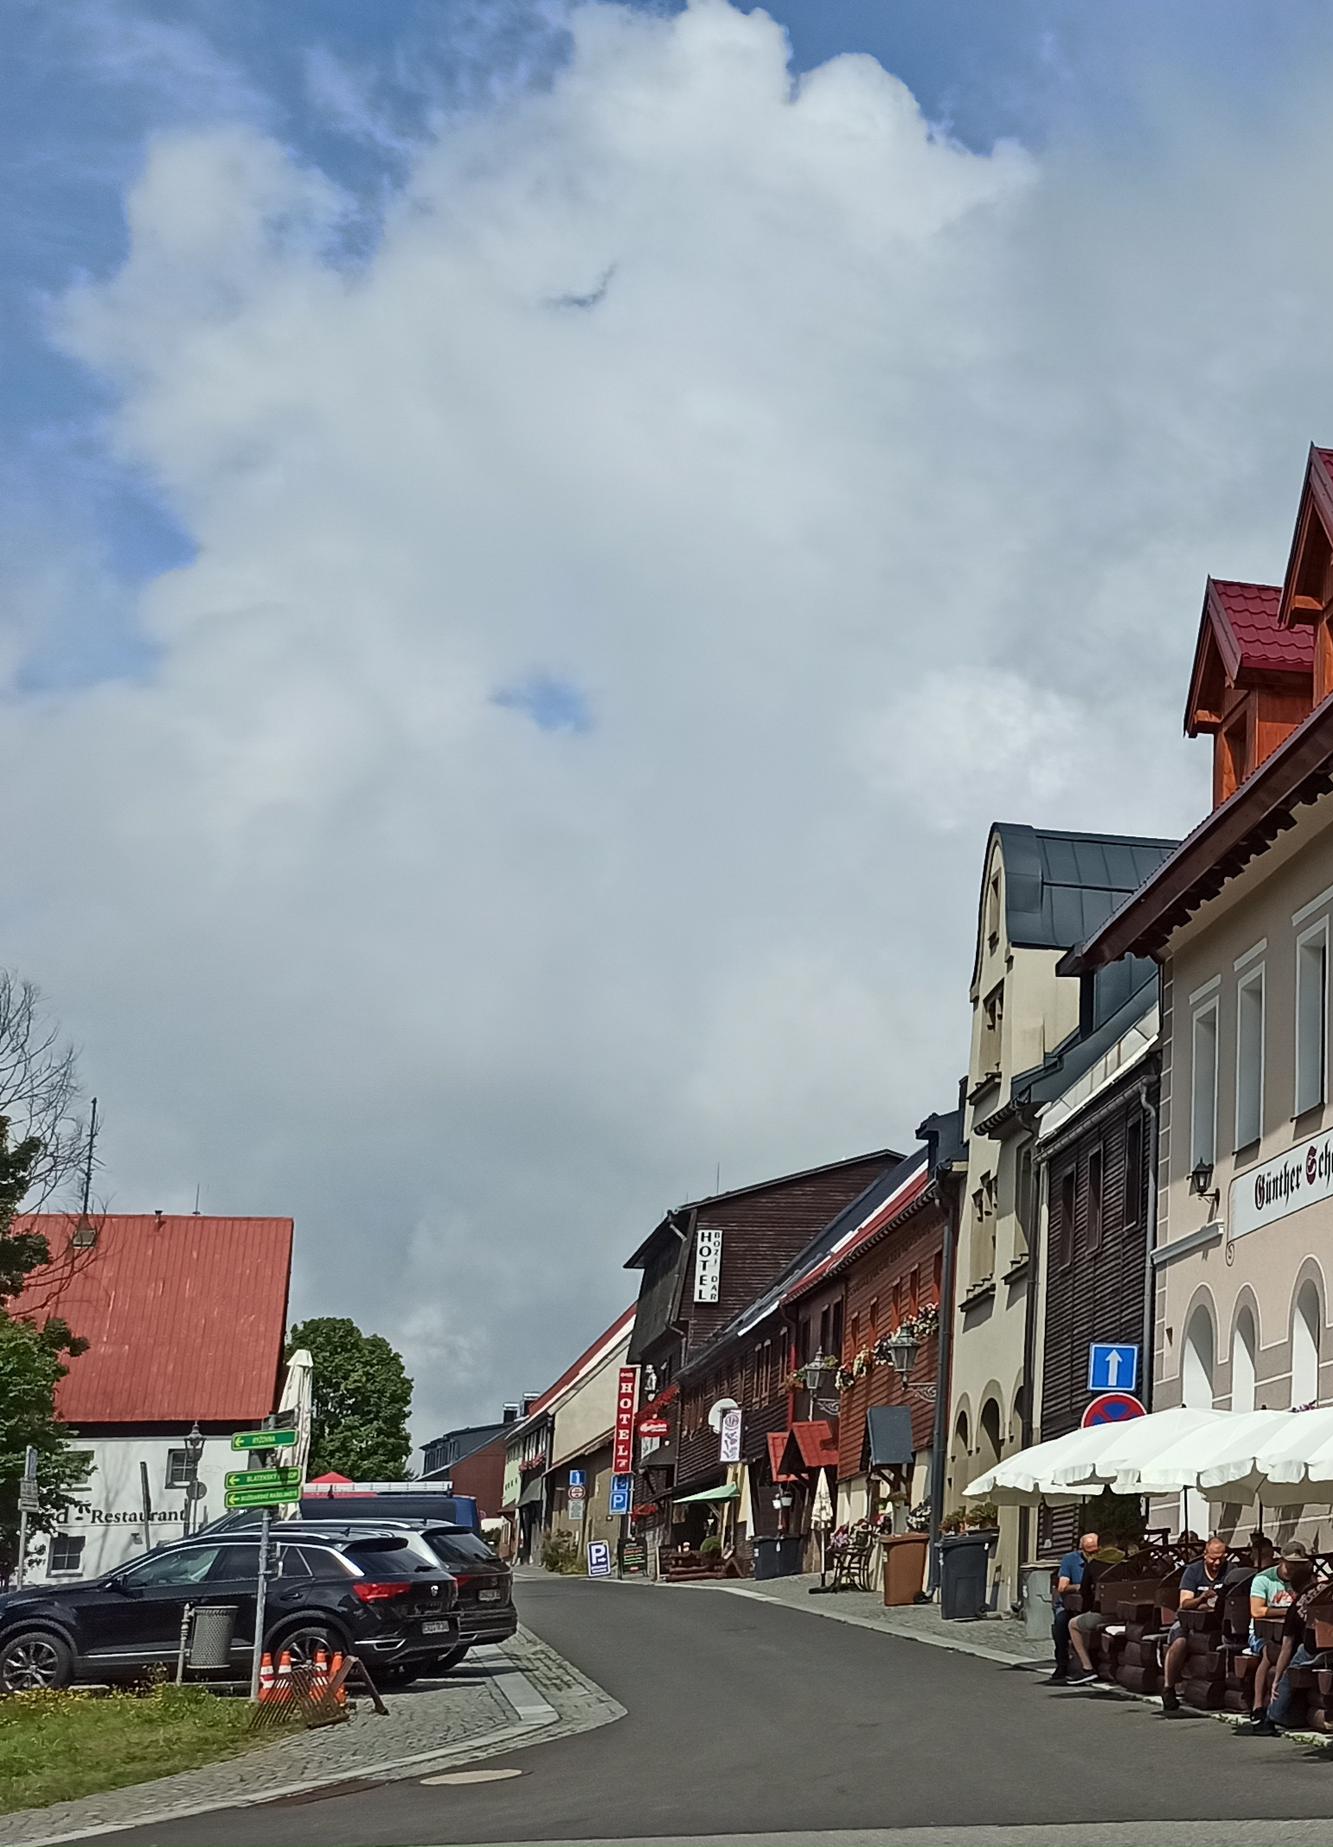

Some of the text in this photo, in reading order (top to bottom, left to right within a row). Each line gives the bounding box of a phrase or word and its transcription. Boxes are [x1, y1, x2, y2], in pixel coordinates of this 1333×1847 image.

[1254, 1159, 1303, 1210] Günther
[698, 1231, 712, 1300] HOTEL
[617, 1382, 633, 1456] HOTEL
[91, 1508, 187, 1524] Restaurant
